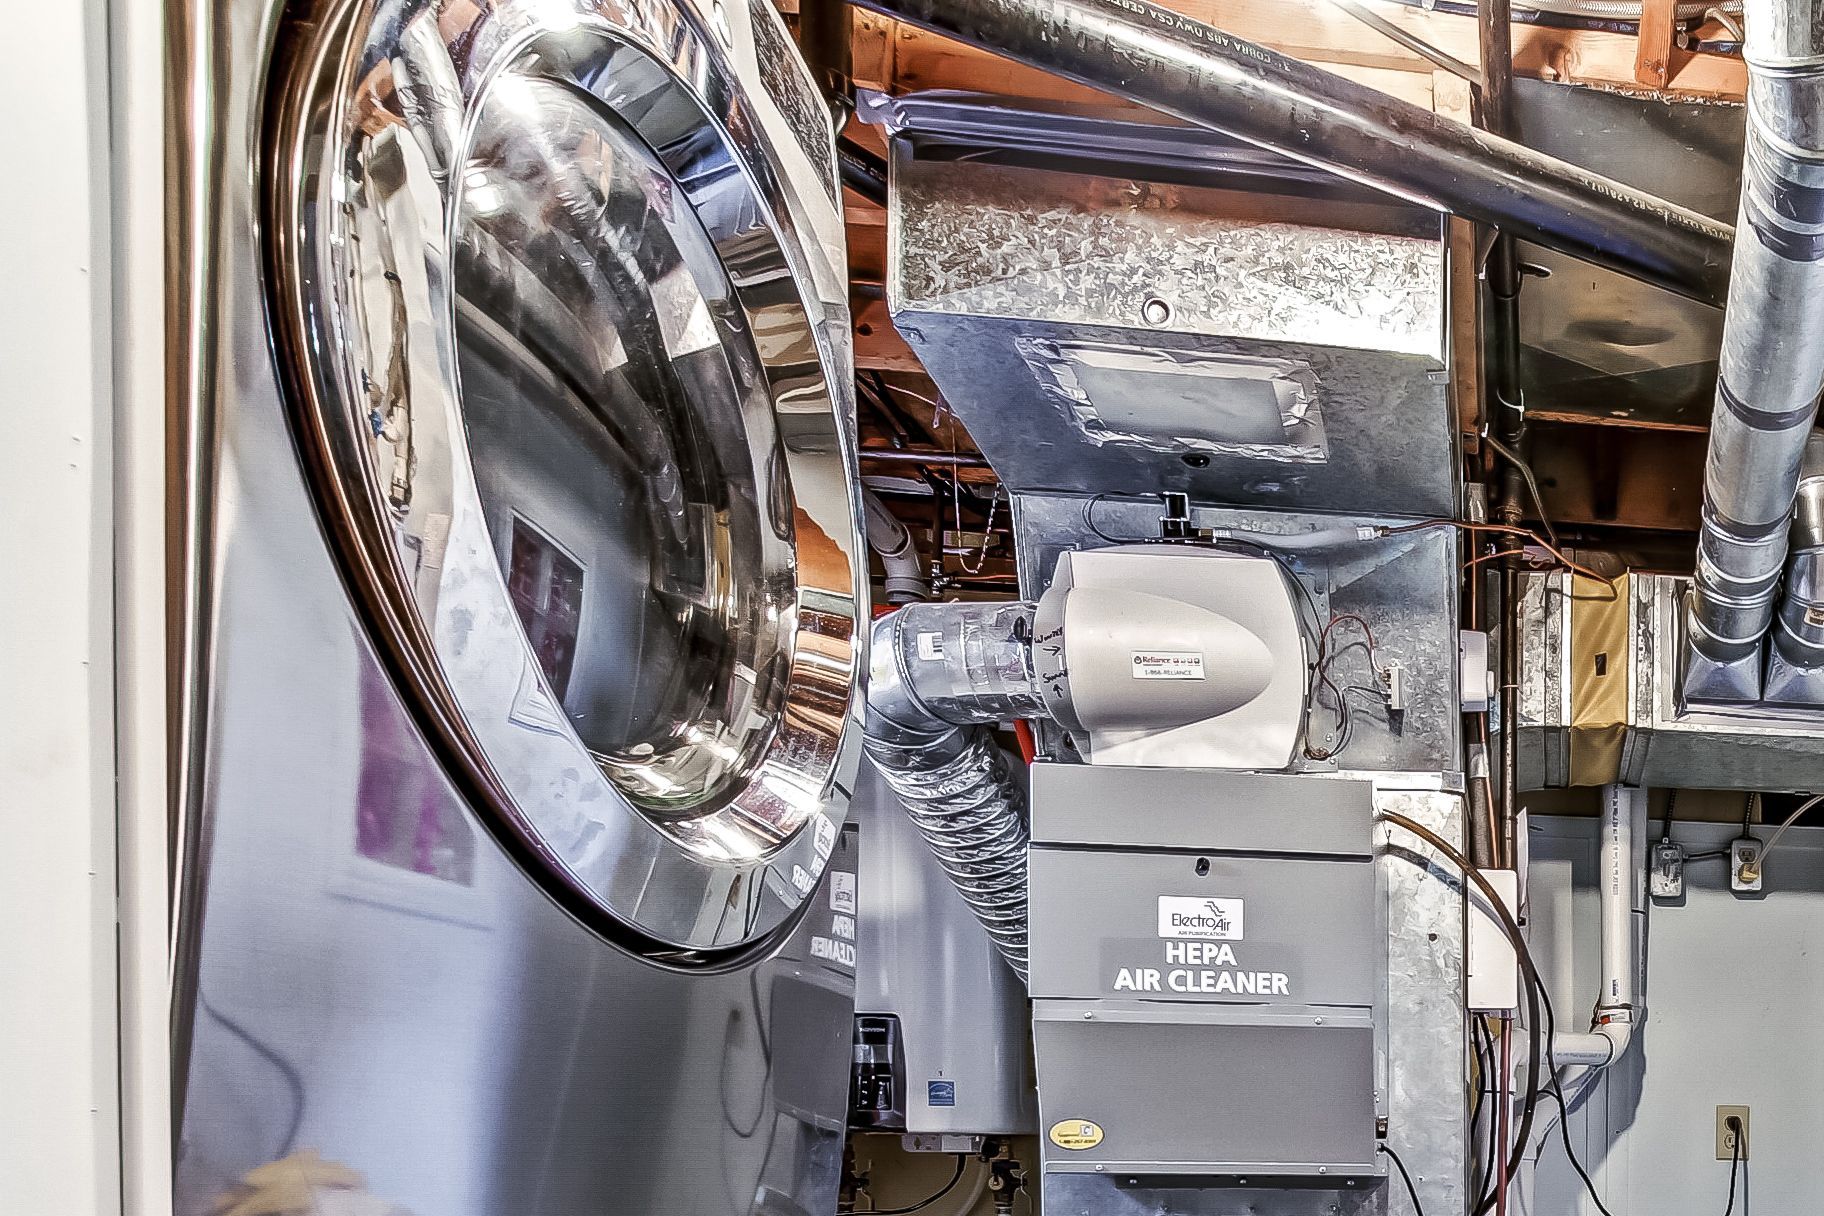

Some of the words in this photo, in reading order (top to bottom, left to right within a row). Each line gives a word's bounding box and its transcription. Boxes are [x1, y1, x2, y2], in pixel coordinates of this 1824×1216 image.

[1149, 9, 1174, 26] CSA
[1165, 941, 1238, 966] HEPA
[1113, 967, 1162, 992] AIR
[1167, 969, 1290, 996] CLEANER
